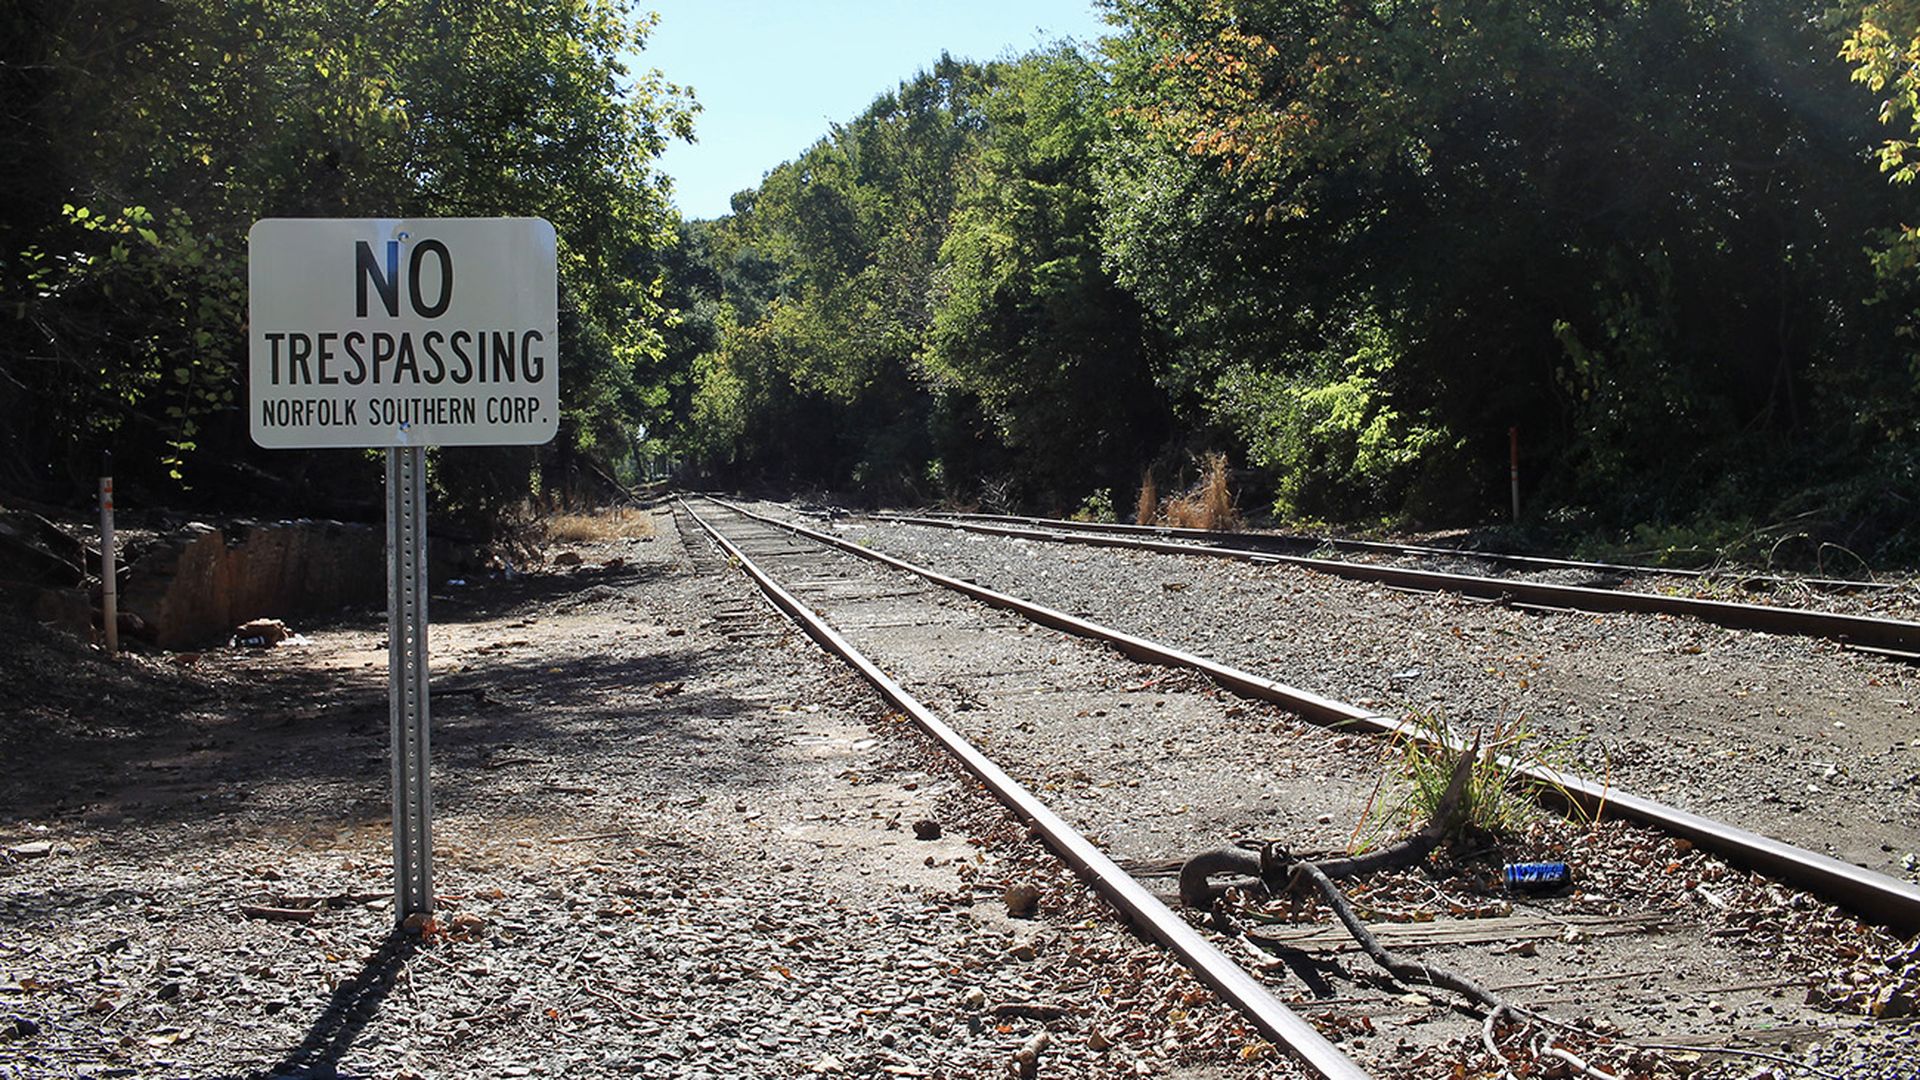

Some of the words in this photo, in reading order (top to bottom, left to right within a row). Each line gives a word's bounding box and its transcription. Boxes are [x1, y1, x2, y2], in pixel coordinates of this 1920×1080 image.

[355, 238, 454, 319] NO
[264, 330, 544, 385] TRESPASSING
[262, 399, 357, 427] NORFOLK
[369, 397, 476, 426] SOUTHERN
[486, 396, 548, 424] CORP.
